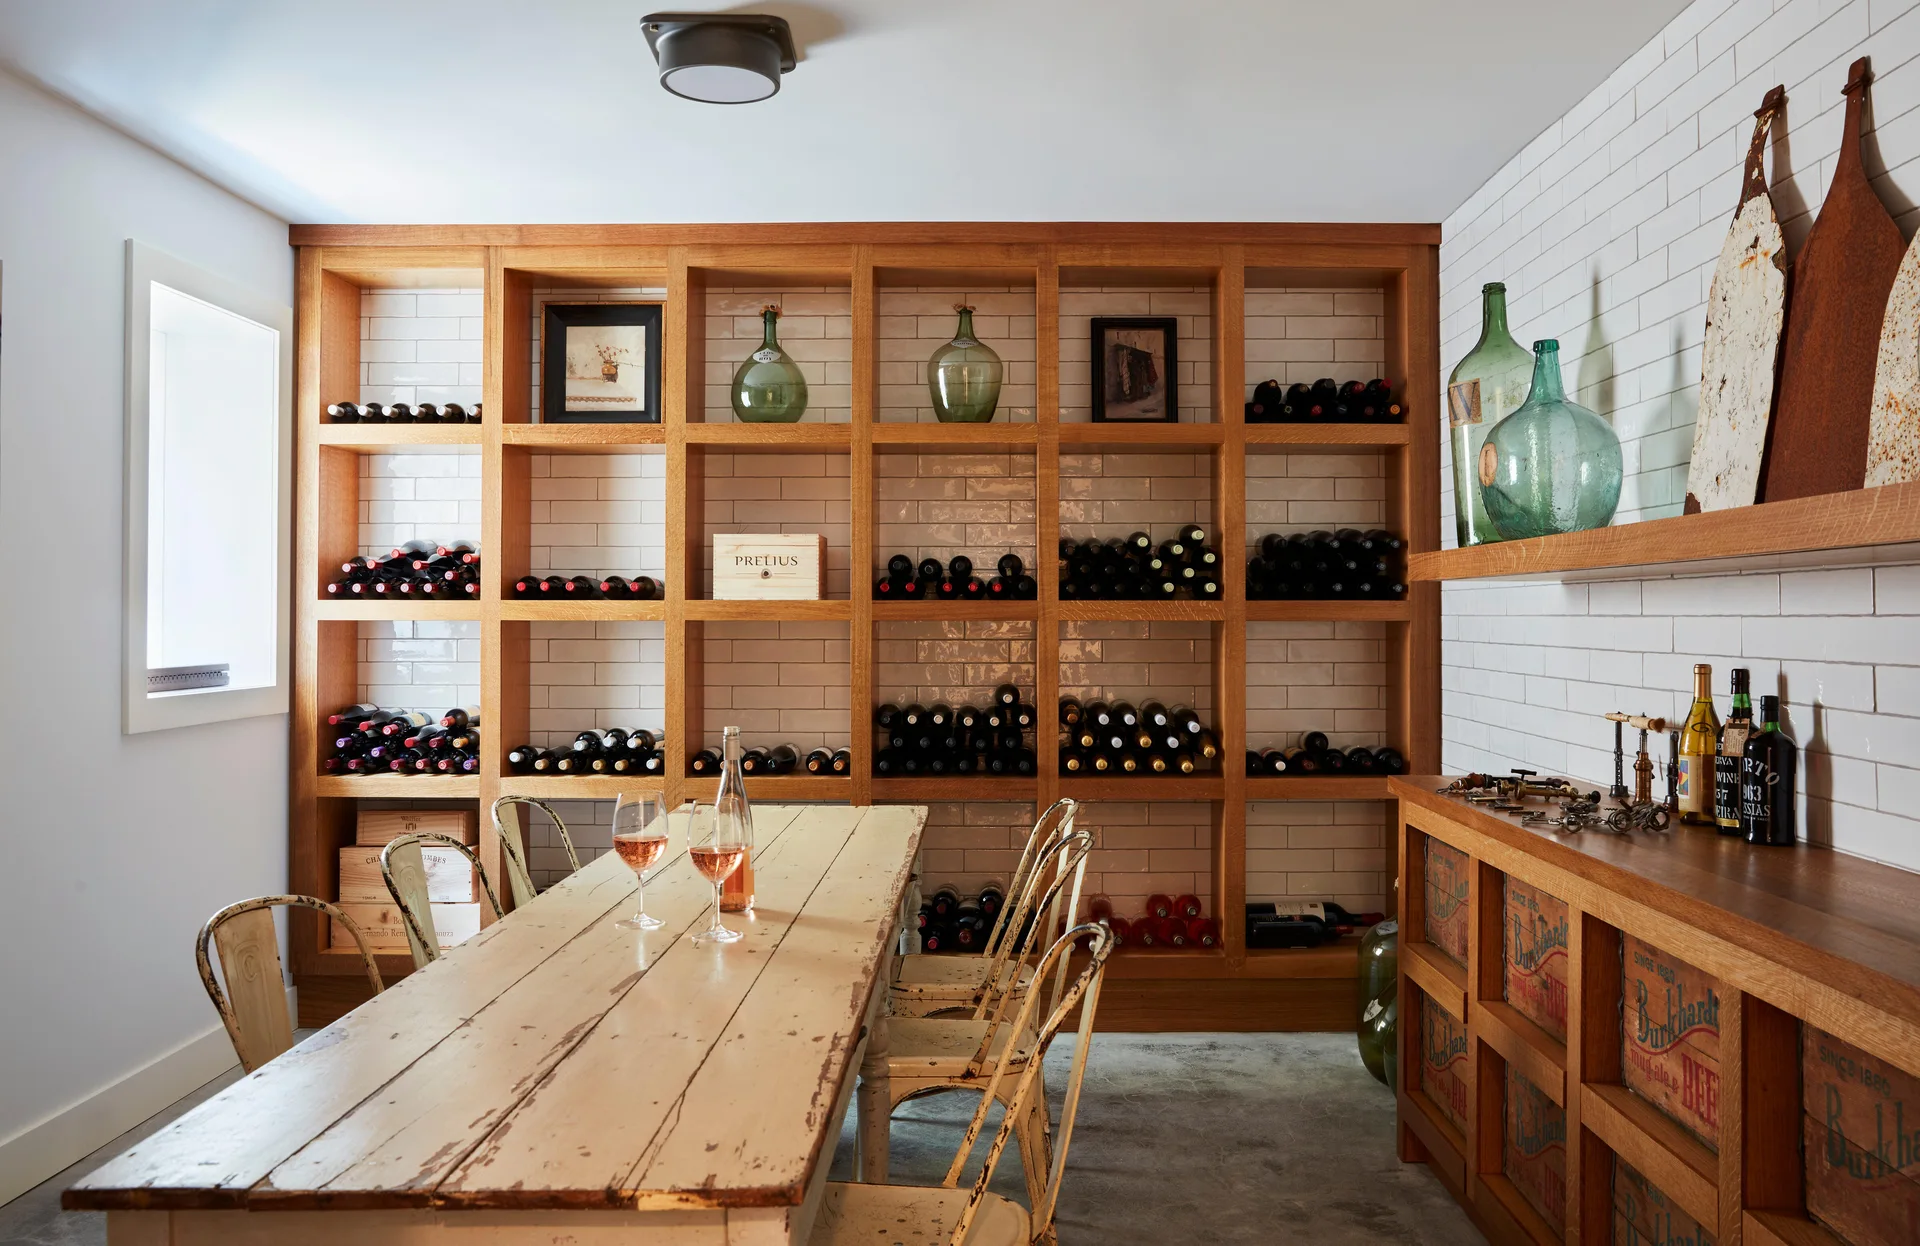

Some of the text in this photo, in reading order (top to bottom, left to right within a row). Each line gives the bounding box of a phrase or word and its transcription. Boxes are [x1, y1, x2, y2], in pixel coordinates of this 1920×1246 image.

[734, 555, 798, 566] PRELIUS
[1743, 757, 1780, 786] RTO
[363, 927, 389, 938] ernando
[1633, 950, 1654, 973] SINCE
[1819, 1045, 1892, 1098] SINCE 1880
[1681, 1052, 1719, 1130] BEE
